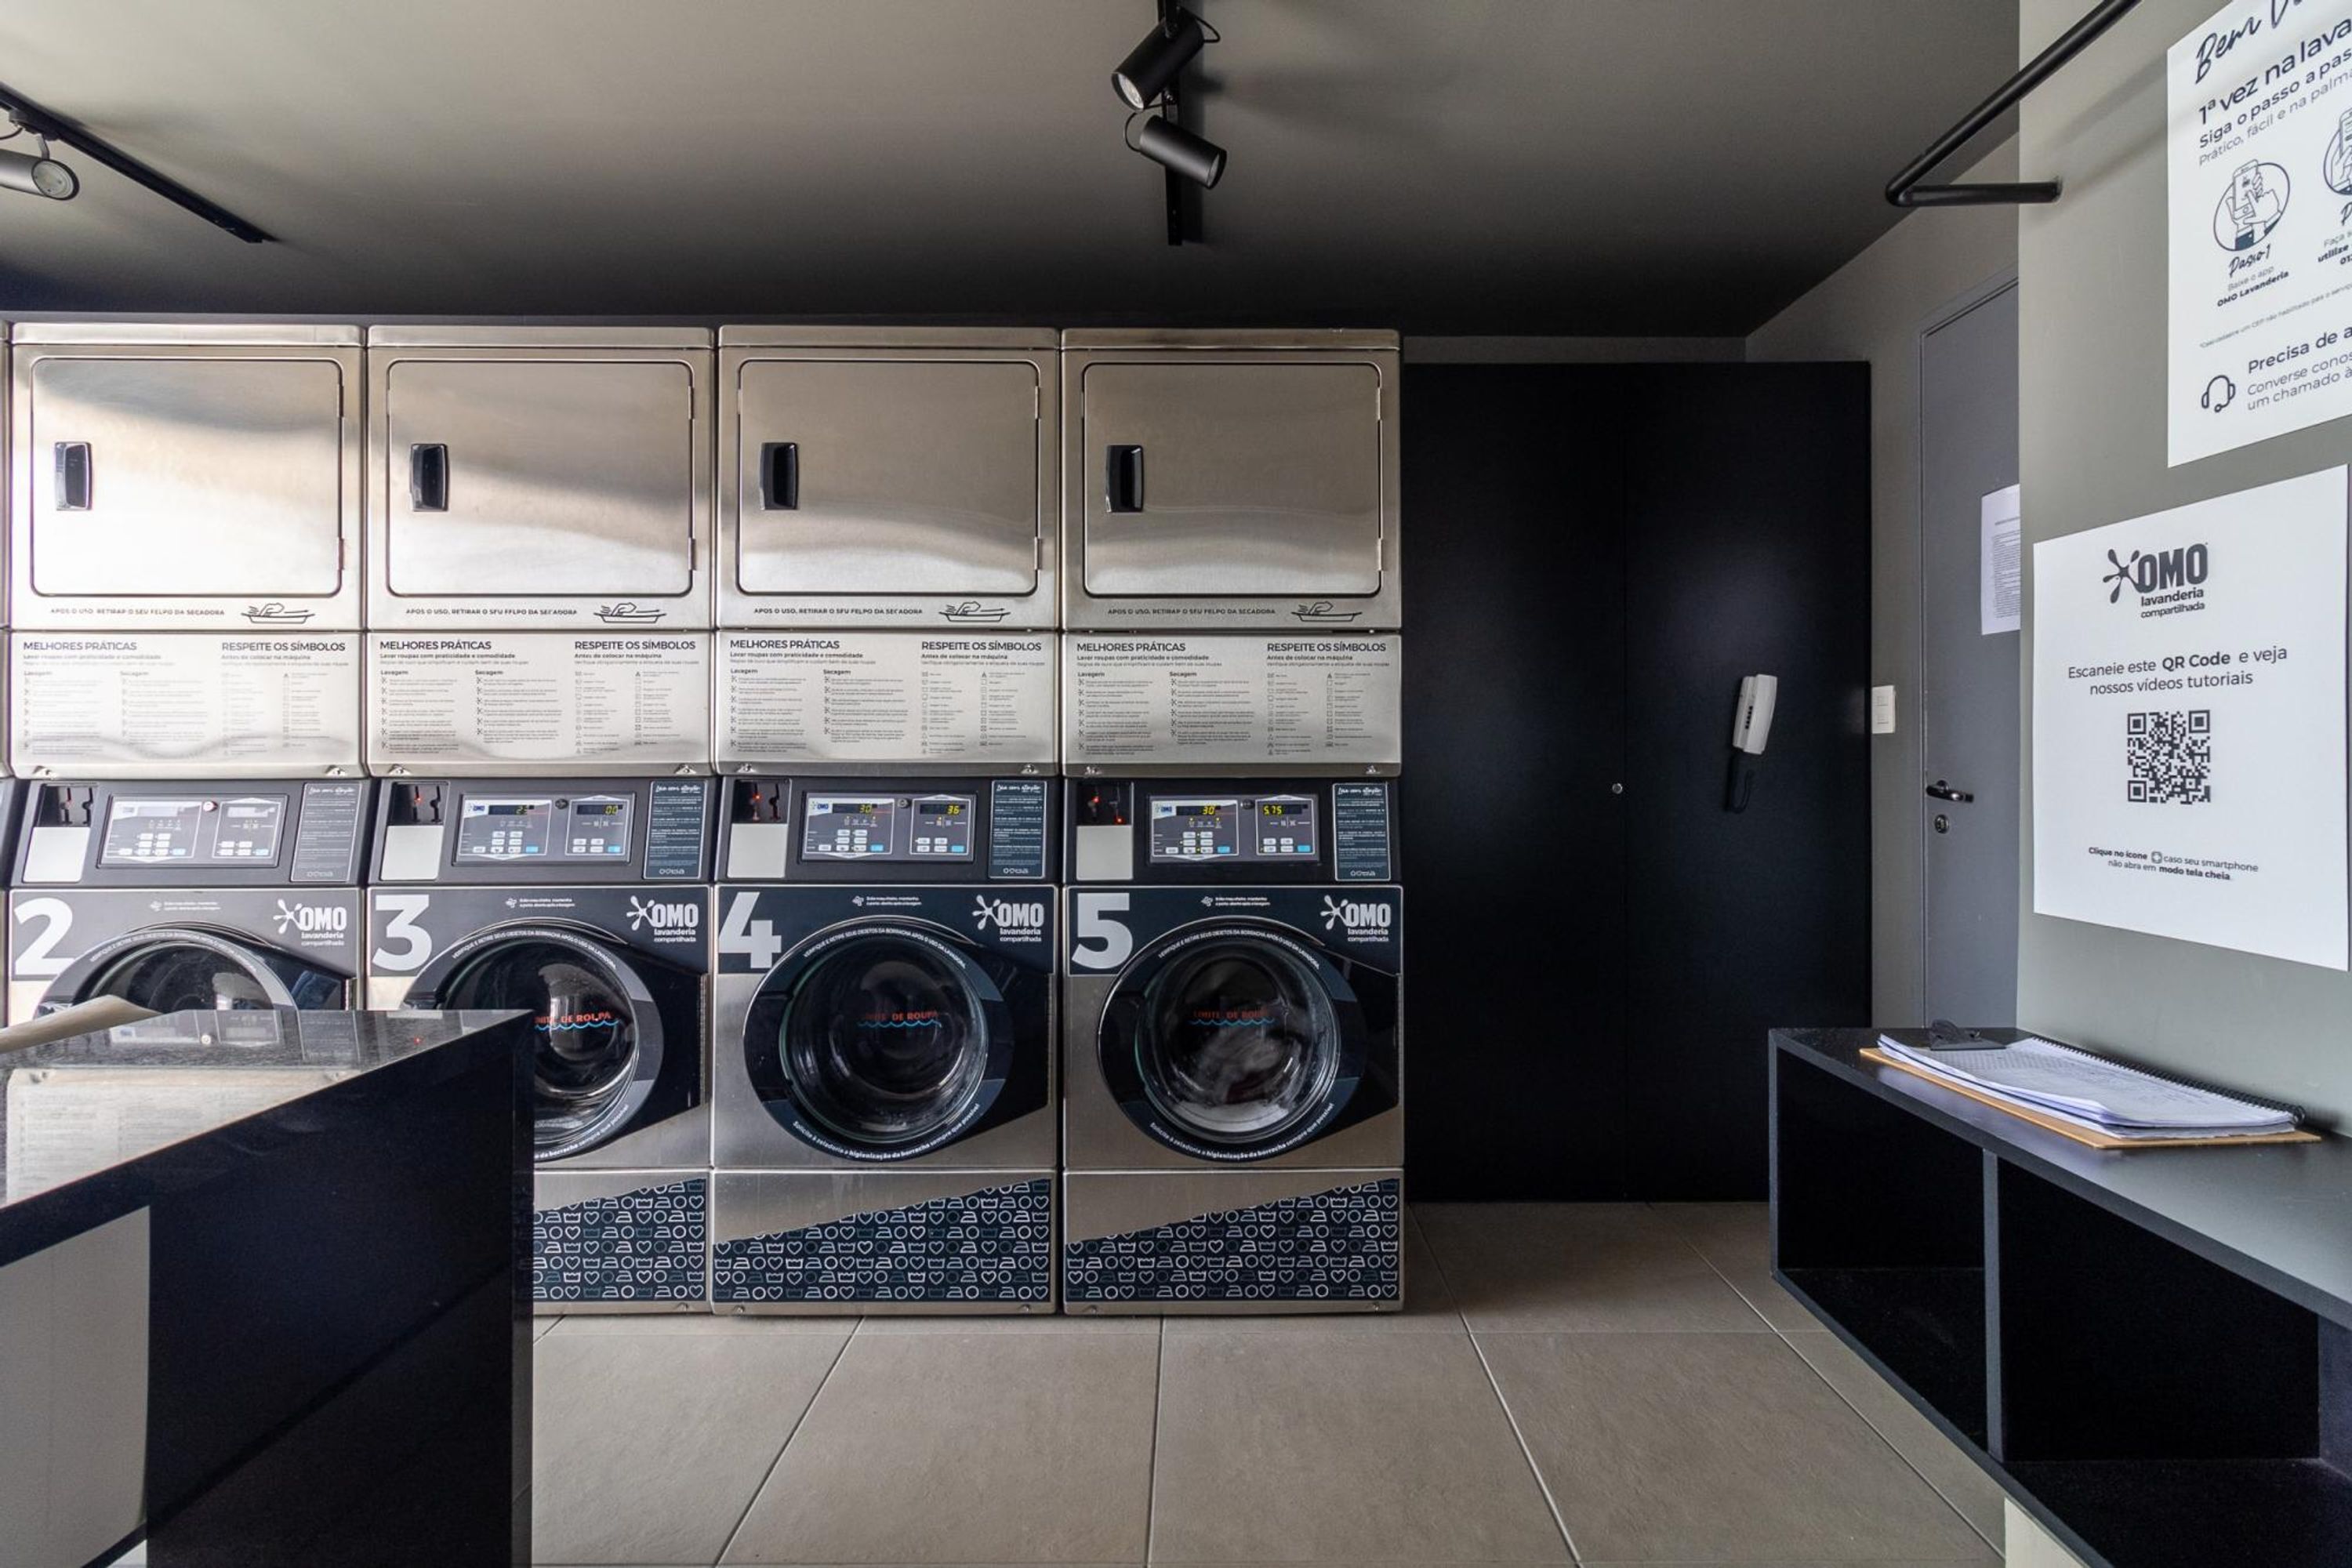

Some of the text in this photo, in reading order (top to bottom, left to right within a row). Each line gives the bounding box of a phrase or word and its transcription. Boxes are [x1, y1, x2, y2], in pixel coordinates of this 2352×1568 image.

[2195, 16, 2262, 85] Bem
[2220, 78, 2258, 111] vez
[2266, 55, 2295, 85] na
[2200, 122, 2232, 148] Siga
[2238, 114, 2247, 125] o
[2251, 82, 2299, 121] passo
[2306, 71, 2315, 84] a
[2278, 110, 2285, 119] e
[2290, 97, 2306, 113] na
[2257, 267, 2274, 278] app
[2217, 293, 2238, 307] OMO
[2249, 343, 2310, 374] Precisa
[2315, 332, 2338, 348] de
[2247, 368, 2308, 395] Converse
[2247, 396, 2270, 410] um
[2273, 372, 2341, 402] chamado
[2138, 543, 2208, 593] OMO
[2141, 586, 2204, 607] lavanderia
[2140, 601, 2205, 619] compartilhada
[223, 641, 345, 651] RESPEITE OS SÍMBOLOS
[380, 640, 492, 650] MELHORES PRÁTICAS
[642, 641, 695, 650] SÍMBOLOS
[731, 639, 840, 649] MELHORES PRÁTICAS
[922, 641, 970, 650] RESPEITE
[989, 641, 1041, 651] SÍMBOLOS
[1077, 641, 1185, 652] MELHORES PRÁTICAS
[1317, 643, 1331, 652] OS
[1334, 641, 1386, 652] SÍMBOLOS
[2068, 645, 2288, 679] Escaneie este QR Code e veja
[2089, 670, 2254, 695] nossos vídeos tutoriais
[1203, 806, 1214, 815] 30
[2089, 847, 2113, 857] Clique
[2163, 855, 2183, 863] caso
[2201, 860, 2259, 872] smartphone
[2107, 859, 2122, 868] não
[2159, 866, 2184, 875] modo
[2186, 868, 2203, 877] tela
[299, 907, 347, 931] OMO
[651, 903, 699, 927] OMO
[997, 903, 1044, 926] OMO
[1345, 903, 1391, 926] OMO
[13, 898, 75, 975] 2
[372, 895, 432, 971] 3
[718, 891, 782, 968] 4
[1072, 893, 1133, 969] 5
